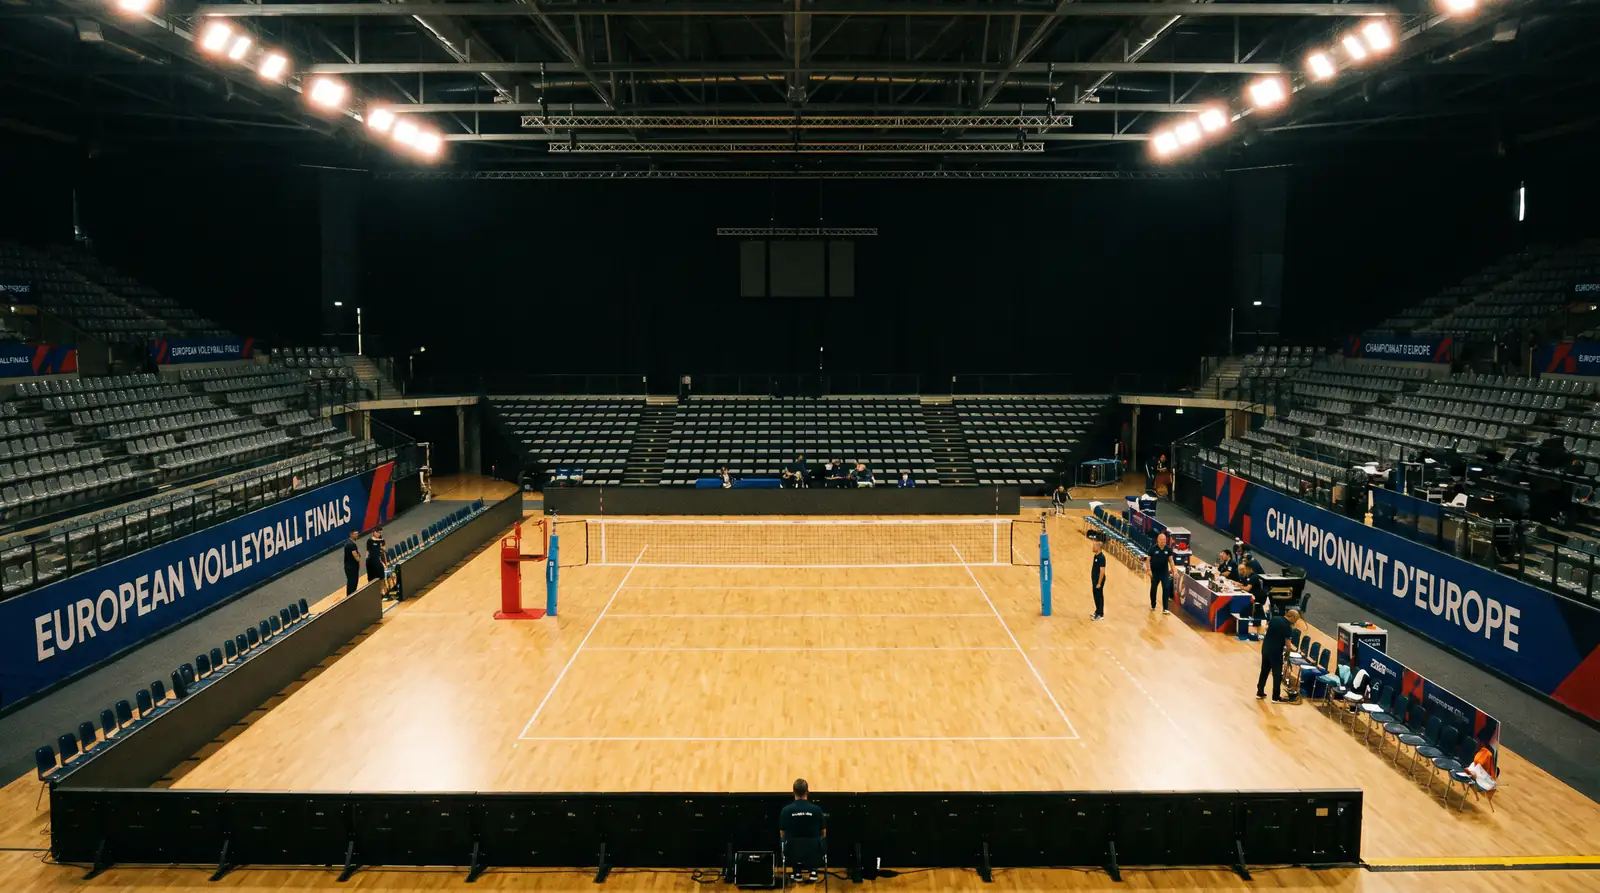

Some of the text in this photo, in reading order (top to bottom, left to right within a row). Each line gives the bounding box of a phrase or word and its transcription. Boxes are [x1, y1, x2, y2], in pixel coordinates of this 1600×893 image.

[9, 355, 29, 364] FINALS
[35, 495, 352, 662] EUROPEAN VOLLEYBALL FINALS
[1266, 507, 1521, 652] CHAMPIONNAT D'EUROPE
